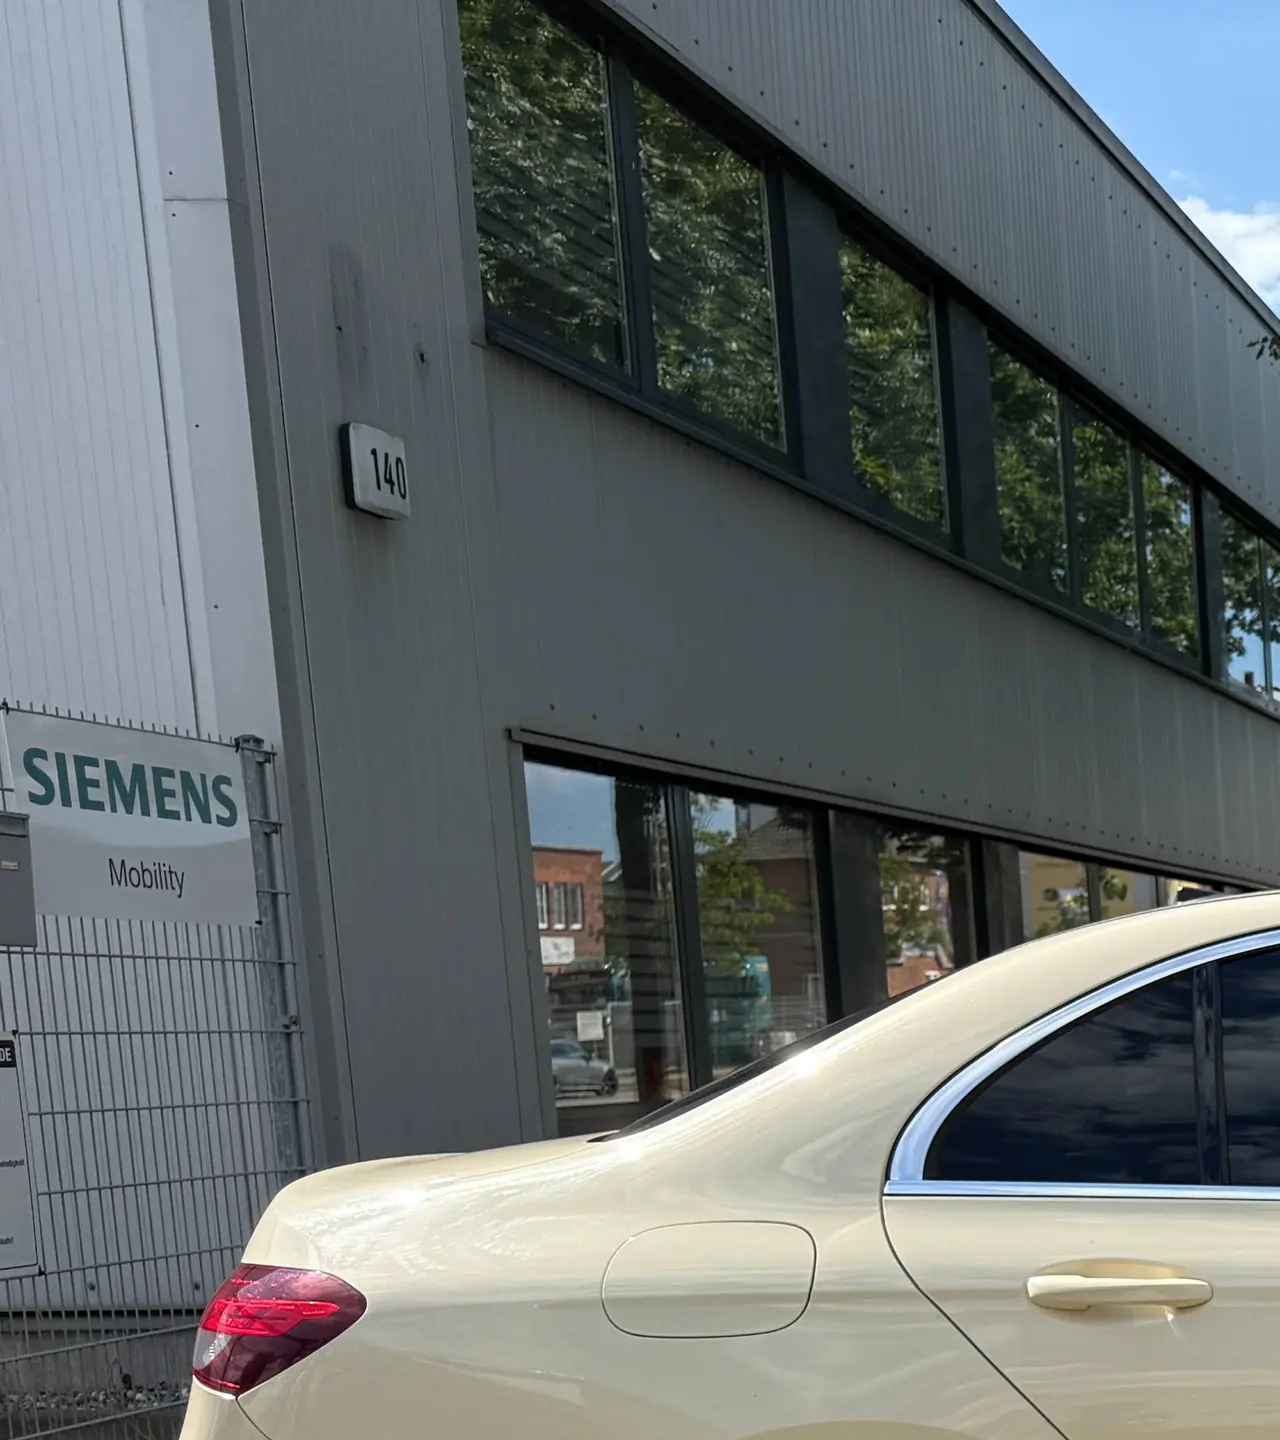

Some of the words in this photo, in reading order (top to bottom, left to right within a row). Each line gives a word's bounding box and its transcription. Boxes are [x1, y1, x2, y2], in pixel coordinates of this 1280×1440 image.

[370, 448, 407, 500] 140
[23, 747, 238, 828] SIEMENS
[108, 857, 185, 899] Mobility
